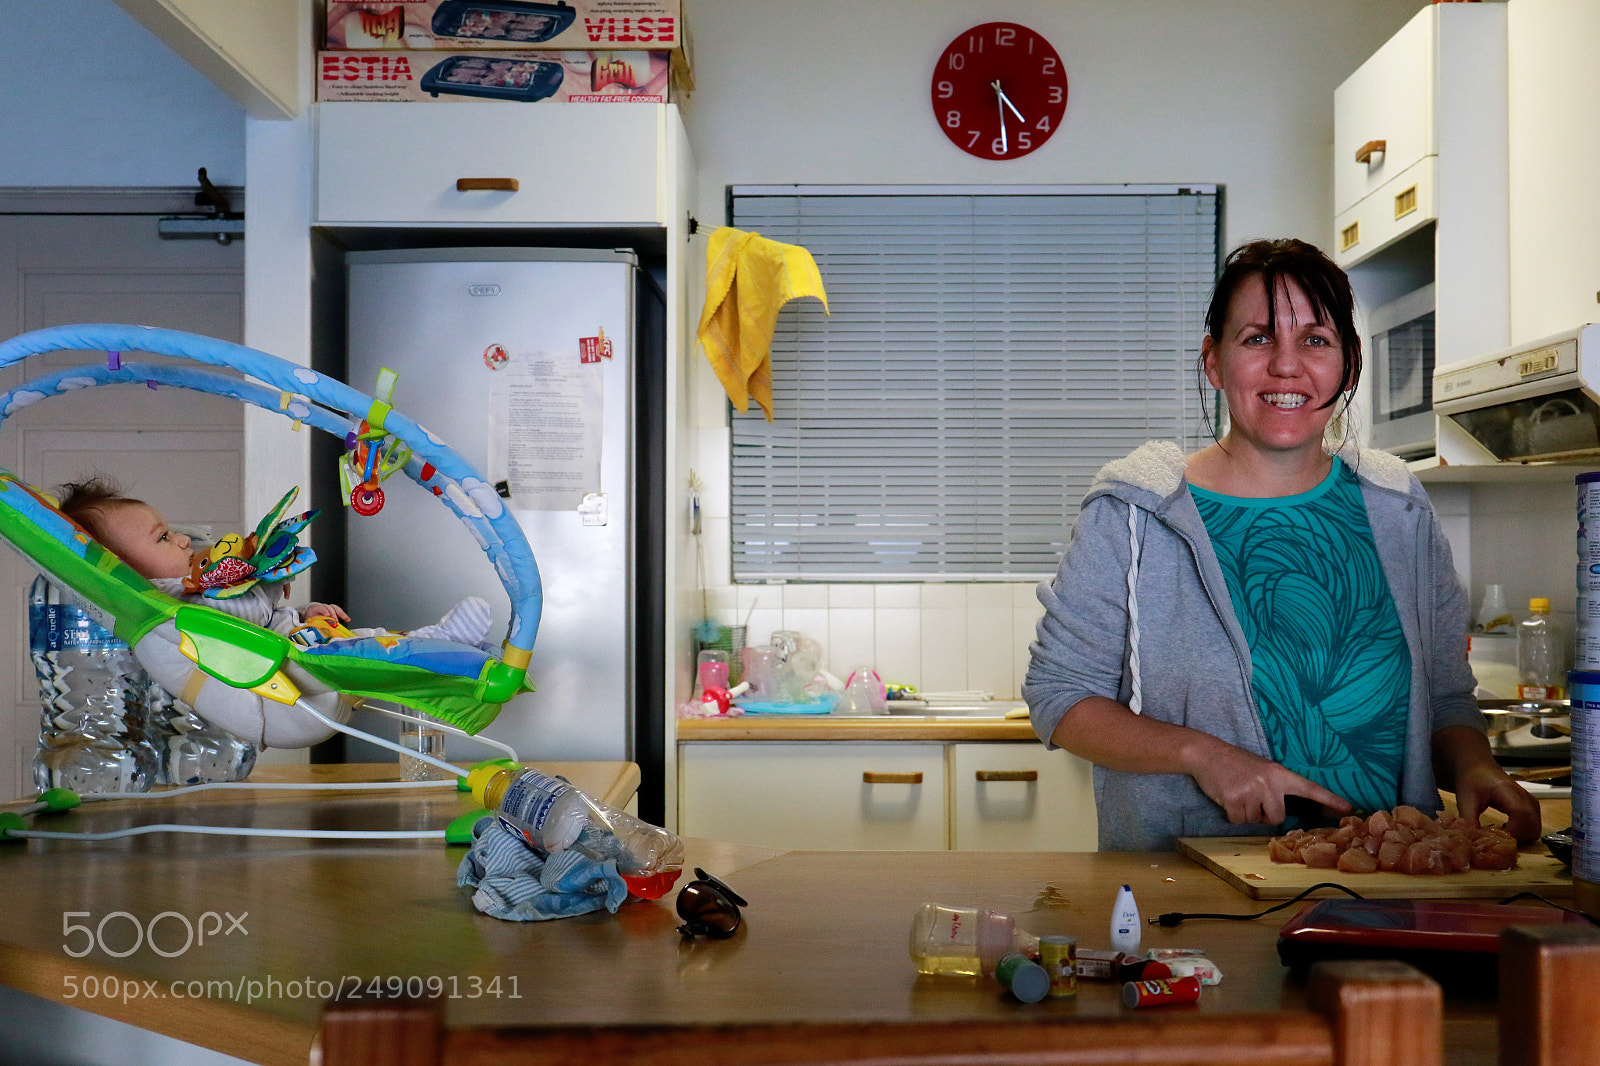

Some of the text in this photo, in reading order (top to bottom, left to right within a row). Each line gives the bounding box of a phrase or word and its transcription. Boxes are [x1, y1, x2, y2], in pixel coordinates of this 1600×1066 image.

[584, 17, 674, 42] ESTIA
[996, 28, 1016, 46] 12
[969, 36, 984, 53] 11
[1028, 37, 1034, 54] 1
[323, 56, 413, 81] ESTIA
[948, 52, 965, 70] 10
[1042, 57, 1056, 74] 2
[938, 80, 954, 98] 9
[1048, 86, 1063, 104] 3
[946, 110, 961, 128] 8
[1036, 116, 1050, 132] 4
[968, 130, 980, 148] 7
[992, 138, 1007, 156] 6
[1018, 132, 1032, 150] 5
